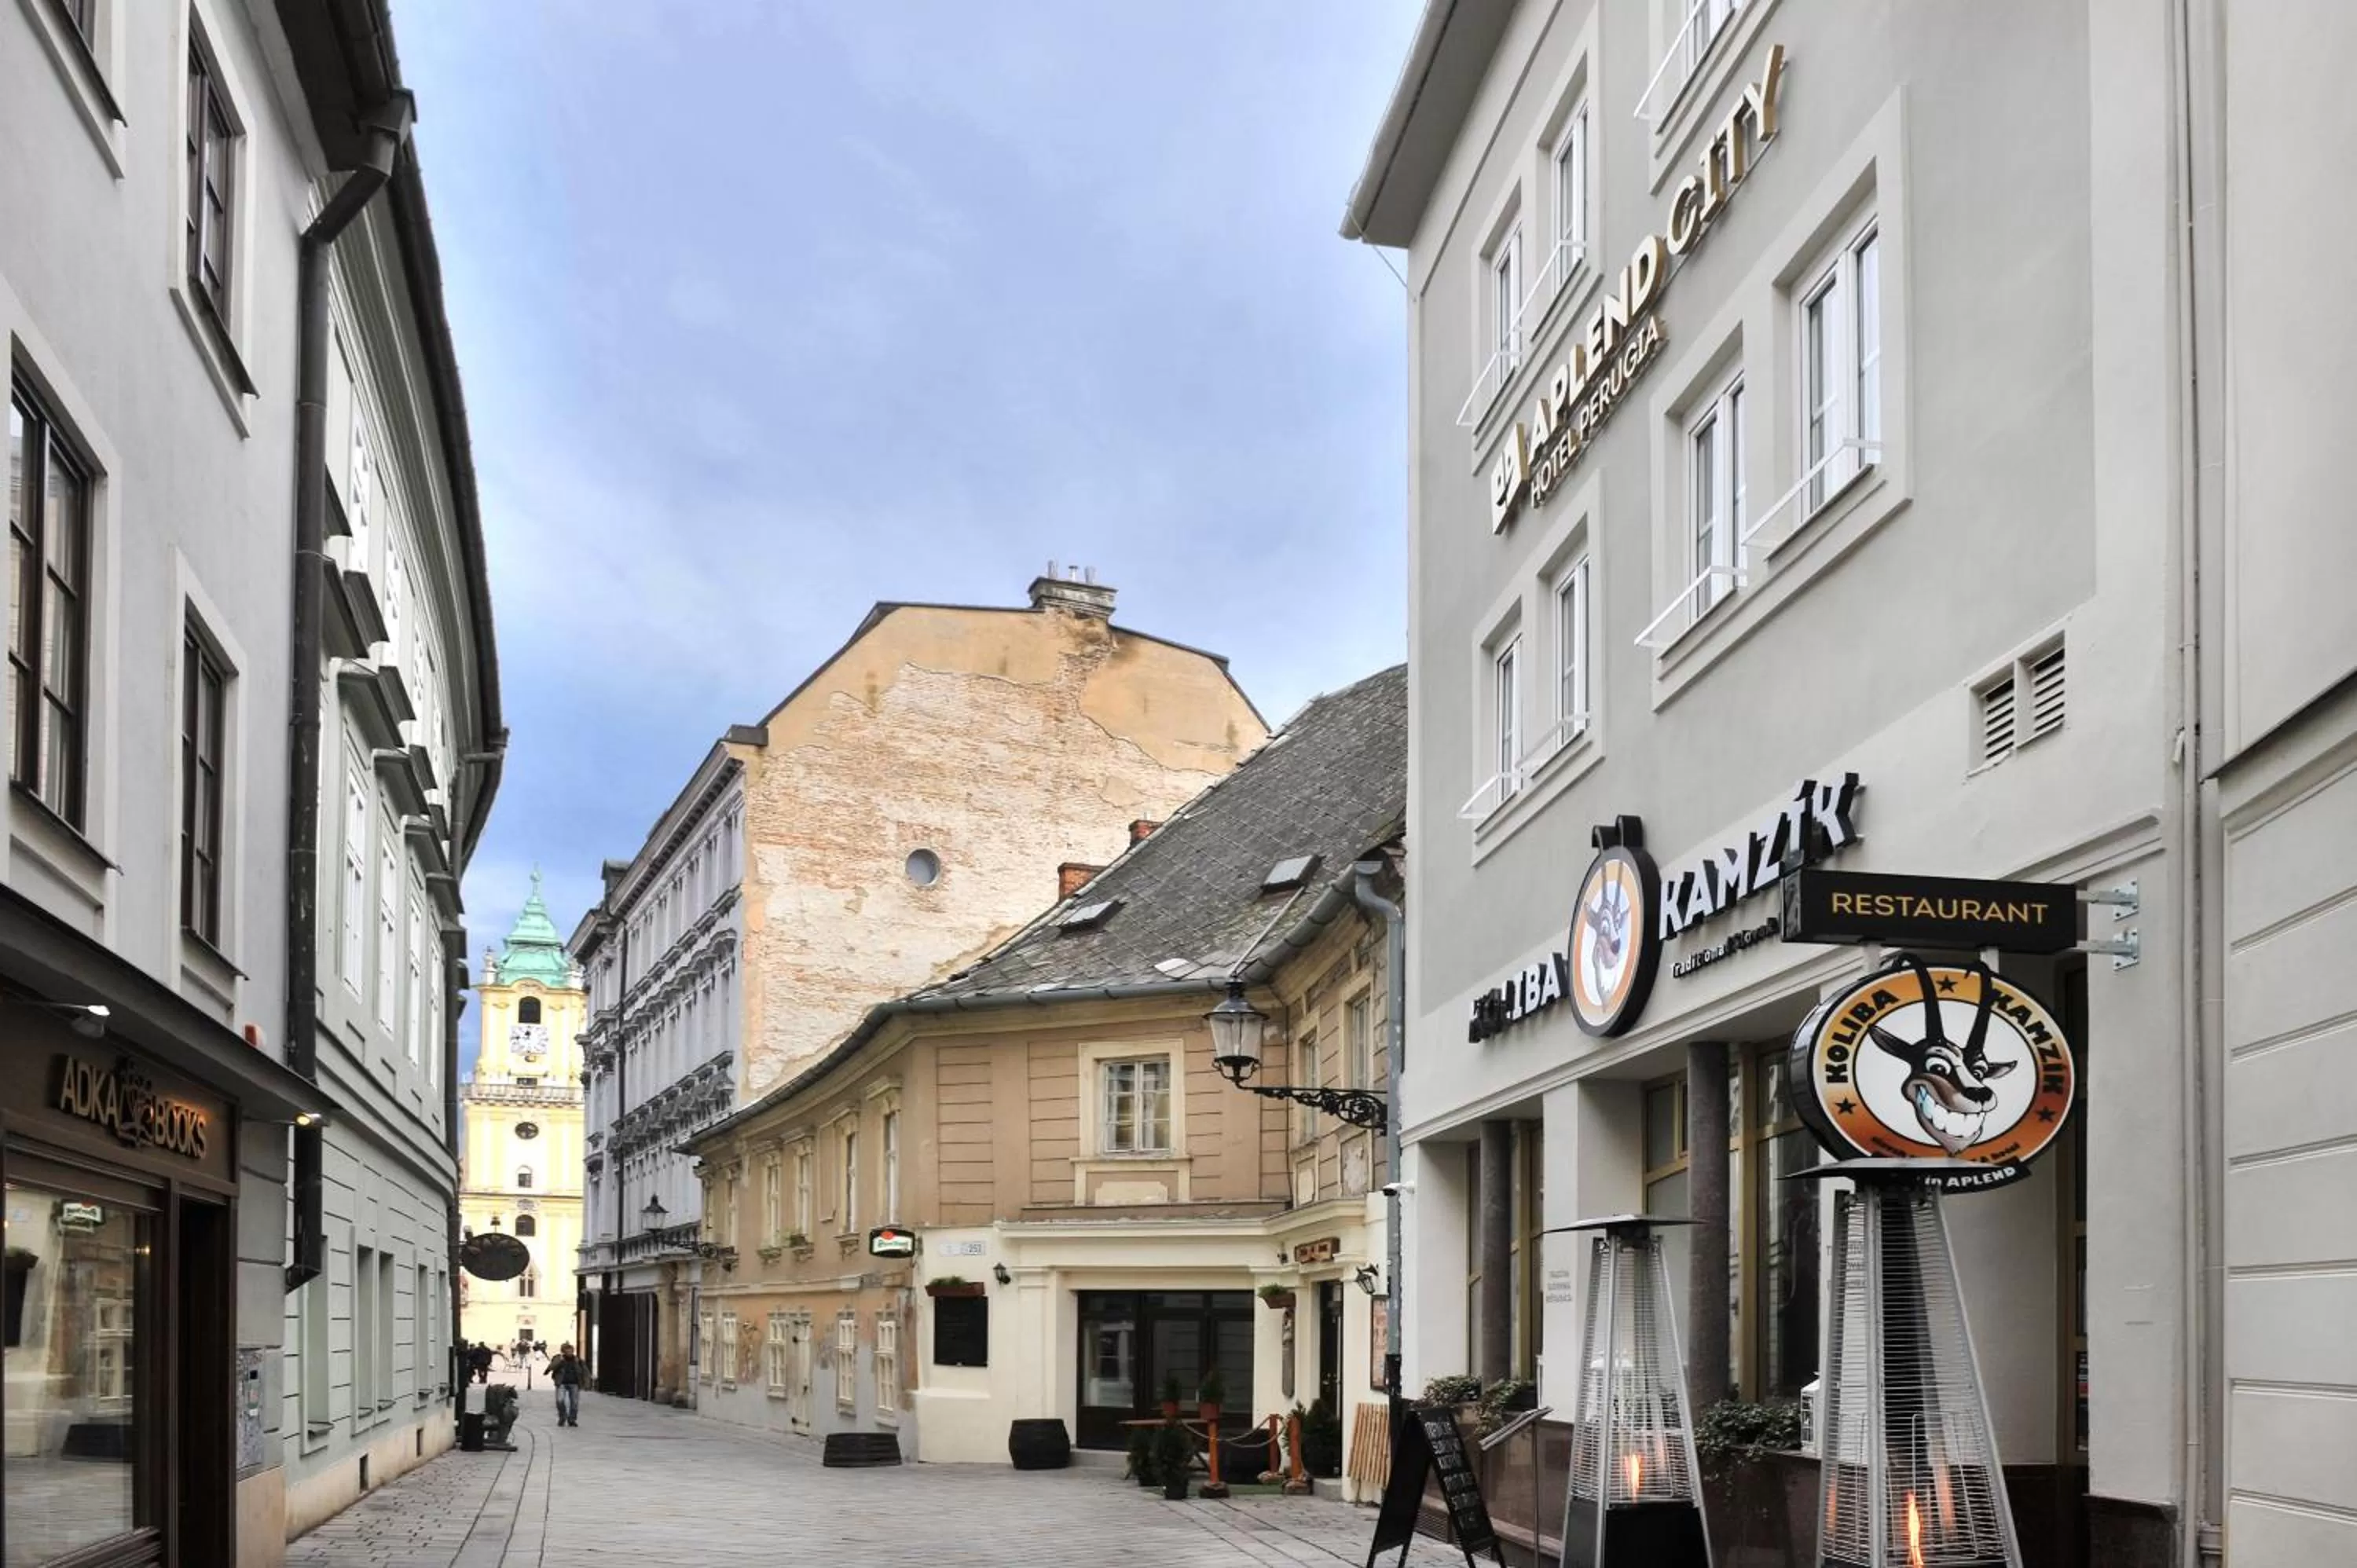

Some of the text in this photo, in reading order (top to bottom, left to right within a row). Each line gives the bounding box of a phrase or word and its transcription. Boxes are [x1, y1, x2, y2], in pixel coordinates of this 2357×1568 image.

[1527, 44, 1784, 467] APLEND CITY
[1531, 314, 1666, 509] HOTEL PERUGIA
[1659, 773, 1857, 942] KAMZÍK
[1831, 892, 2049, 924] RESTAURANT
[1825, 988, 1900, 1083] KOLIBA
[60, 1055, 207, 1160] ADKA BOOKS
[1945, 1166, 2018, 1189] APLEND
